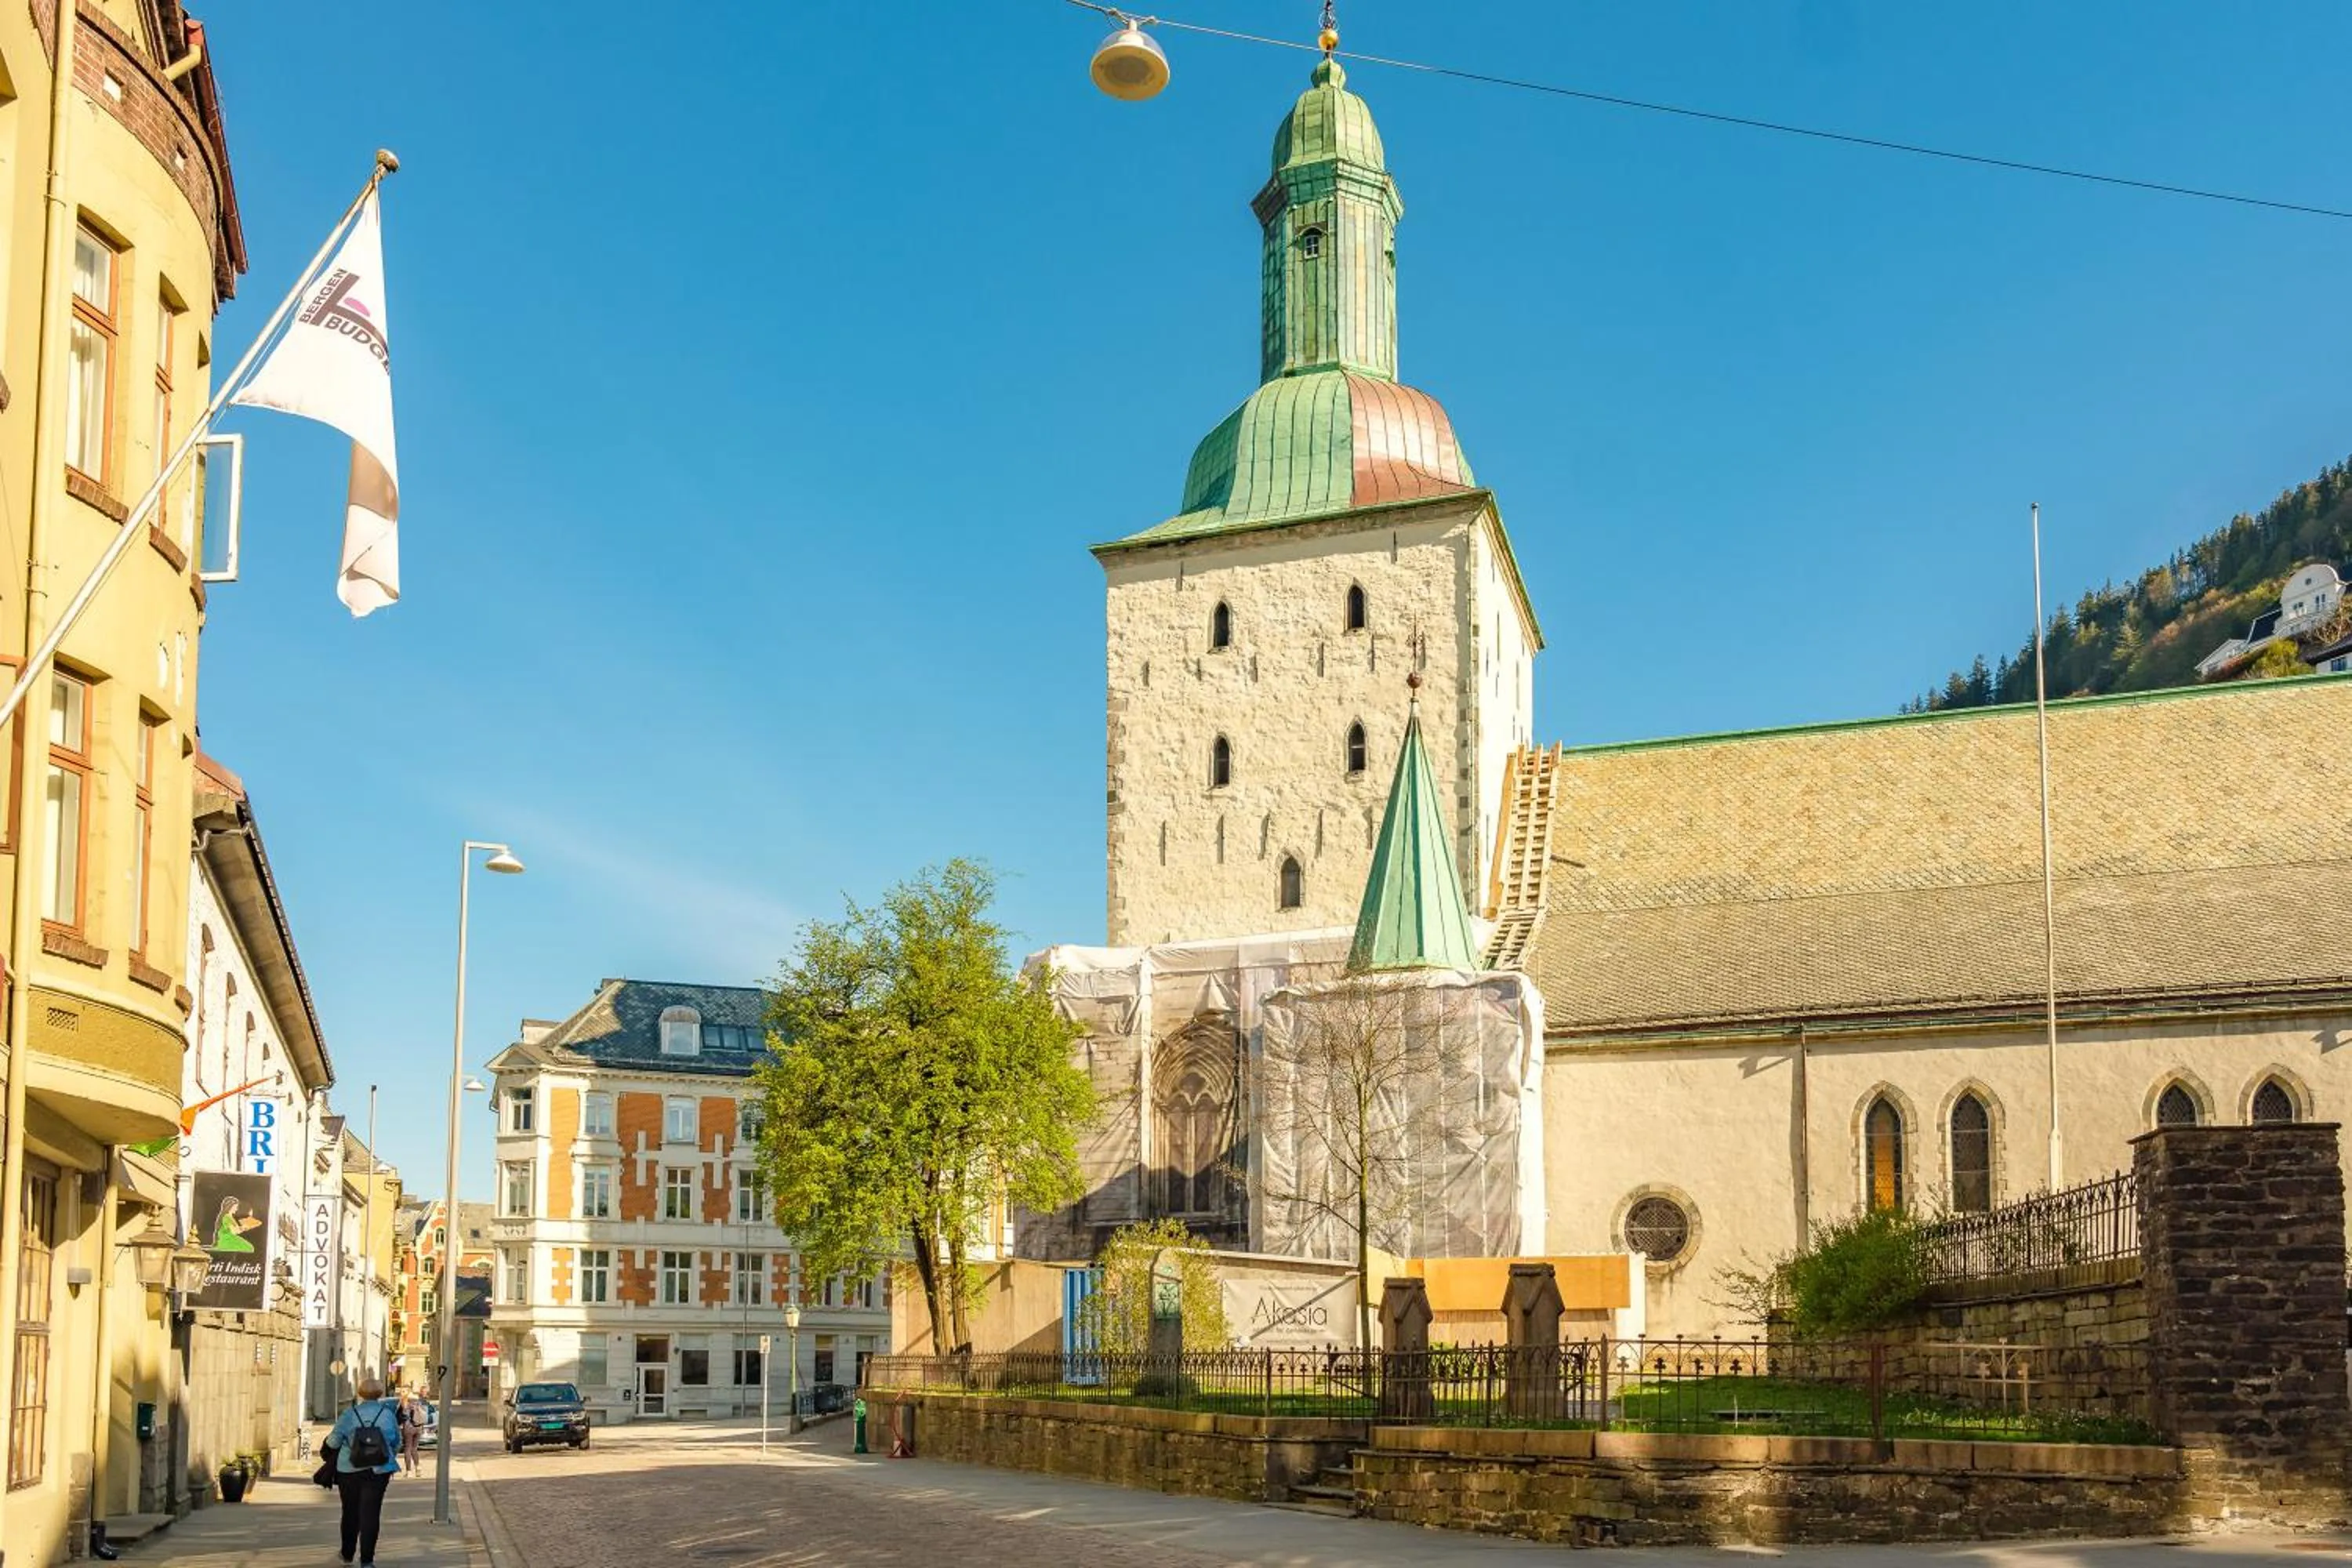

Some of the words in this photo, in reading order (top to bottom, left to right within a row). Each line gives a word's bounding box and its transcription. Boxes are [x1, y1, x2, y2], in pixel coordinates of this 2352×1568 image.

[299, 267, 348, 323] BERGEN
[208, 1261, 224, 1272] rti
[225, 1261, 261, 1274] Indisk
[314, 1203, 328, 1320] ADVOKAT
[204, 1273, 260, 1286] estaurant
[1251, 1296, 1327, 1326] Akasia
